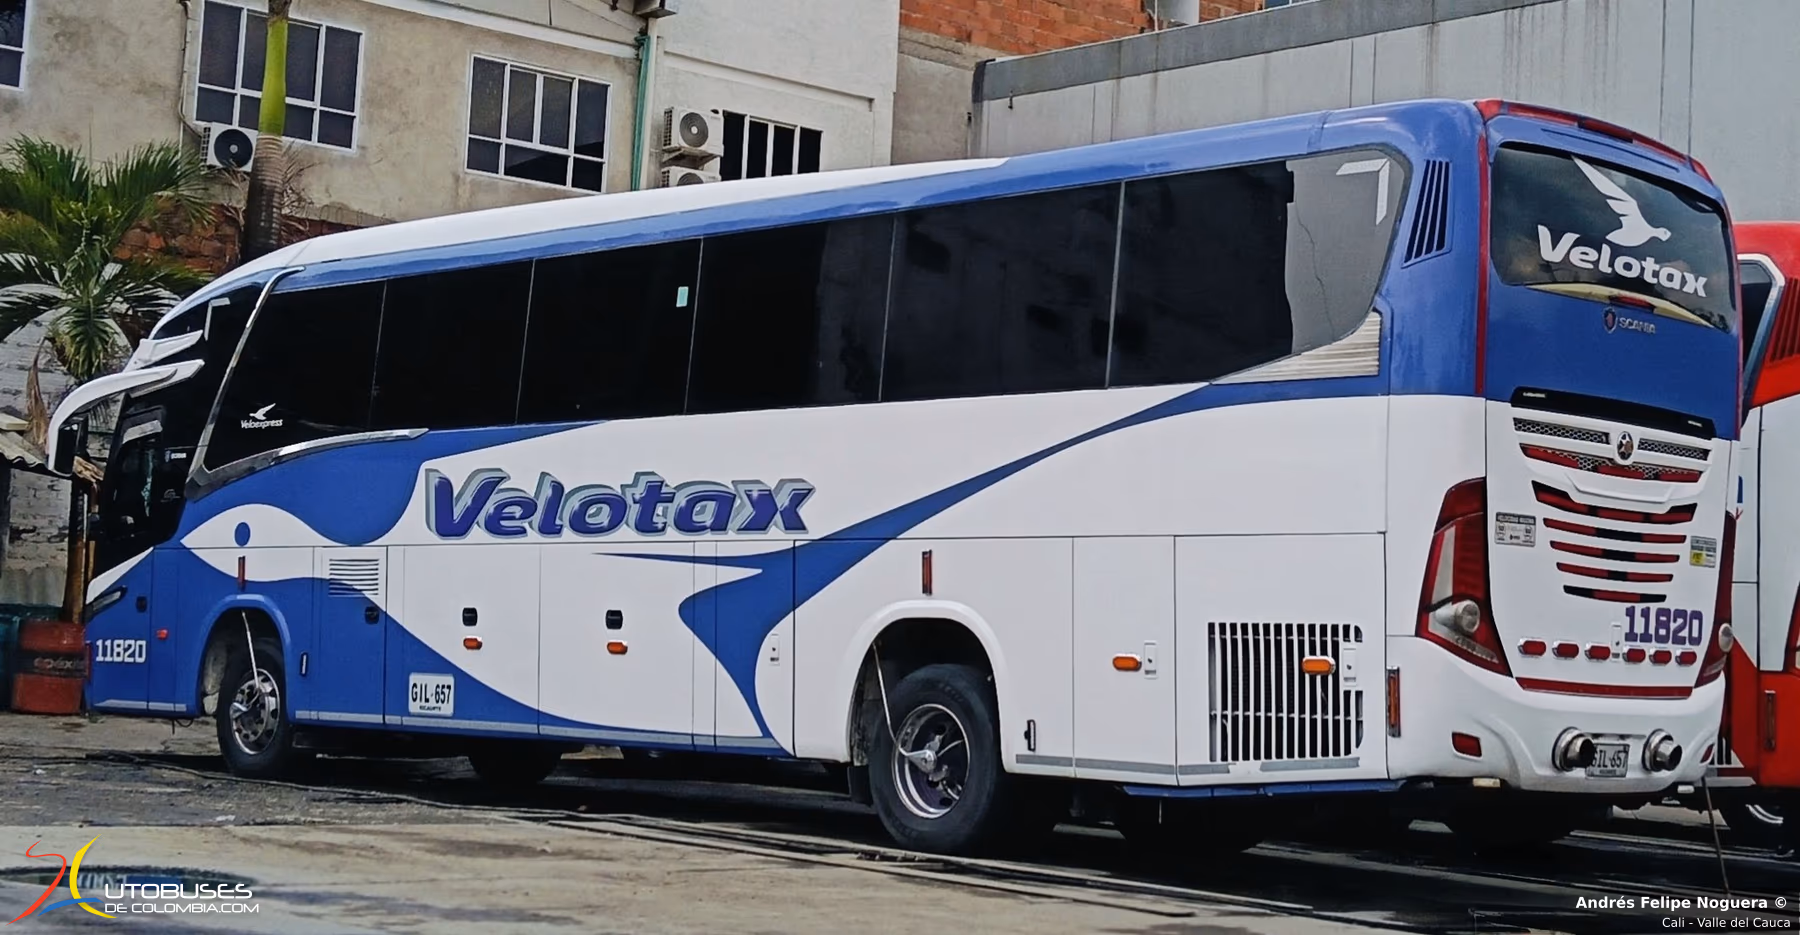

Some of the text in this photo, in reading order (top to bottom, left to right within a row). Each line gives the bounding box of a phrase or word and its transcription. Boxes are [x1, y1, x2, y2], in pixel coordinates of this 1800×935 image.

[1537, 224, 1708, 298] Velotax
[1619, 317, 1656, 334] SCANIA
[241, 419, 283, 430] Veloexpress
[425, 467, 816, 539] Velotax
[1624, 605, 1703, 646] 11820
[95, 639, 147, 663] 11820
